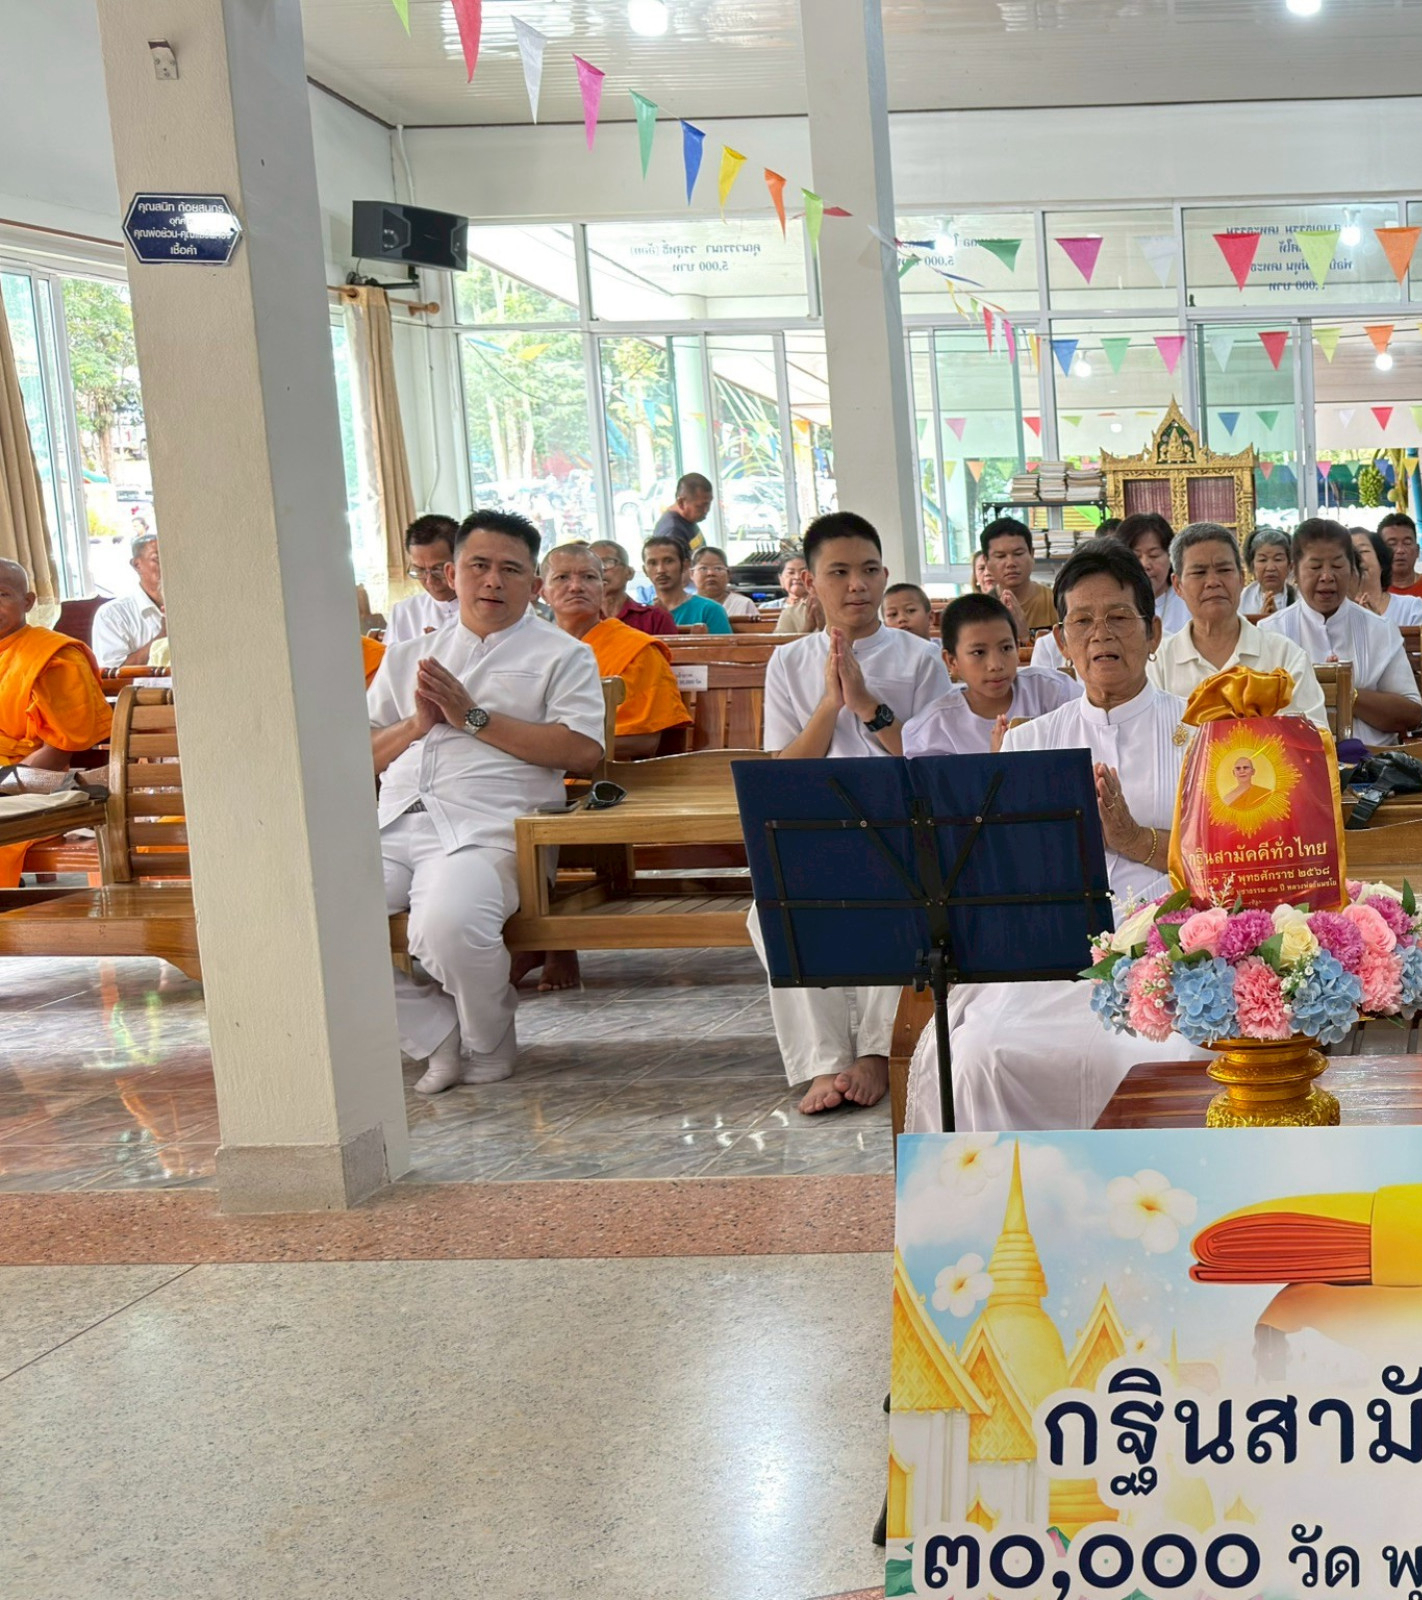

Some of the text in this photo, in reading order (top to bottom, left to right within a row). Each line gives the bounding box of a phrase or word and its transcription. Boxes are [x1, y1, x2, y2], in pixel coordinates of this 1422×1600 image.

[1238, 869, 1295, 886] พุทธศักราช
[1298, 866, 1330, 878] ๒๕๖๘
[924, 1533, 1261, 1600] ๓๐,๐๐๐
[1288, 1523, 1360, 1590] วัด
